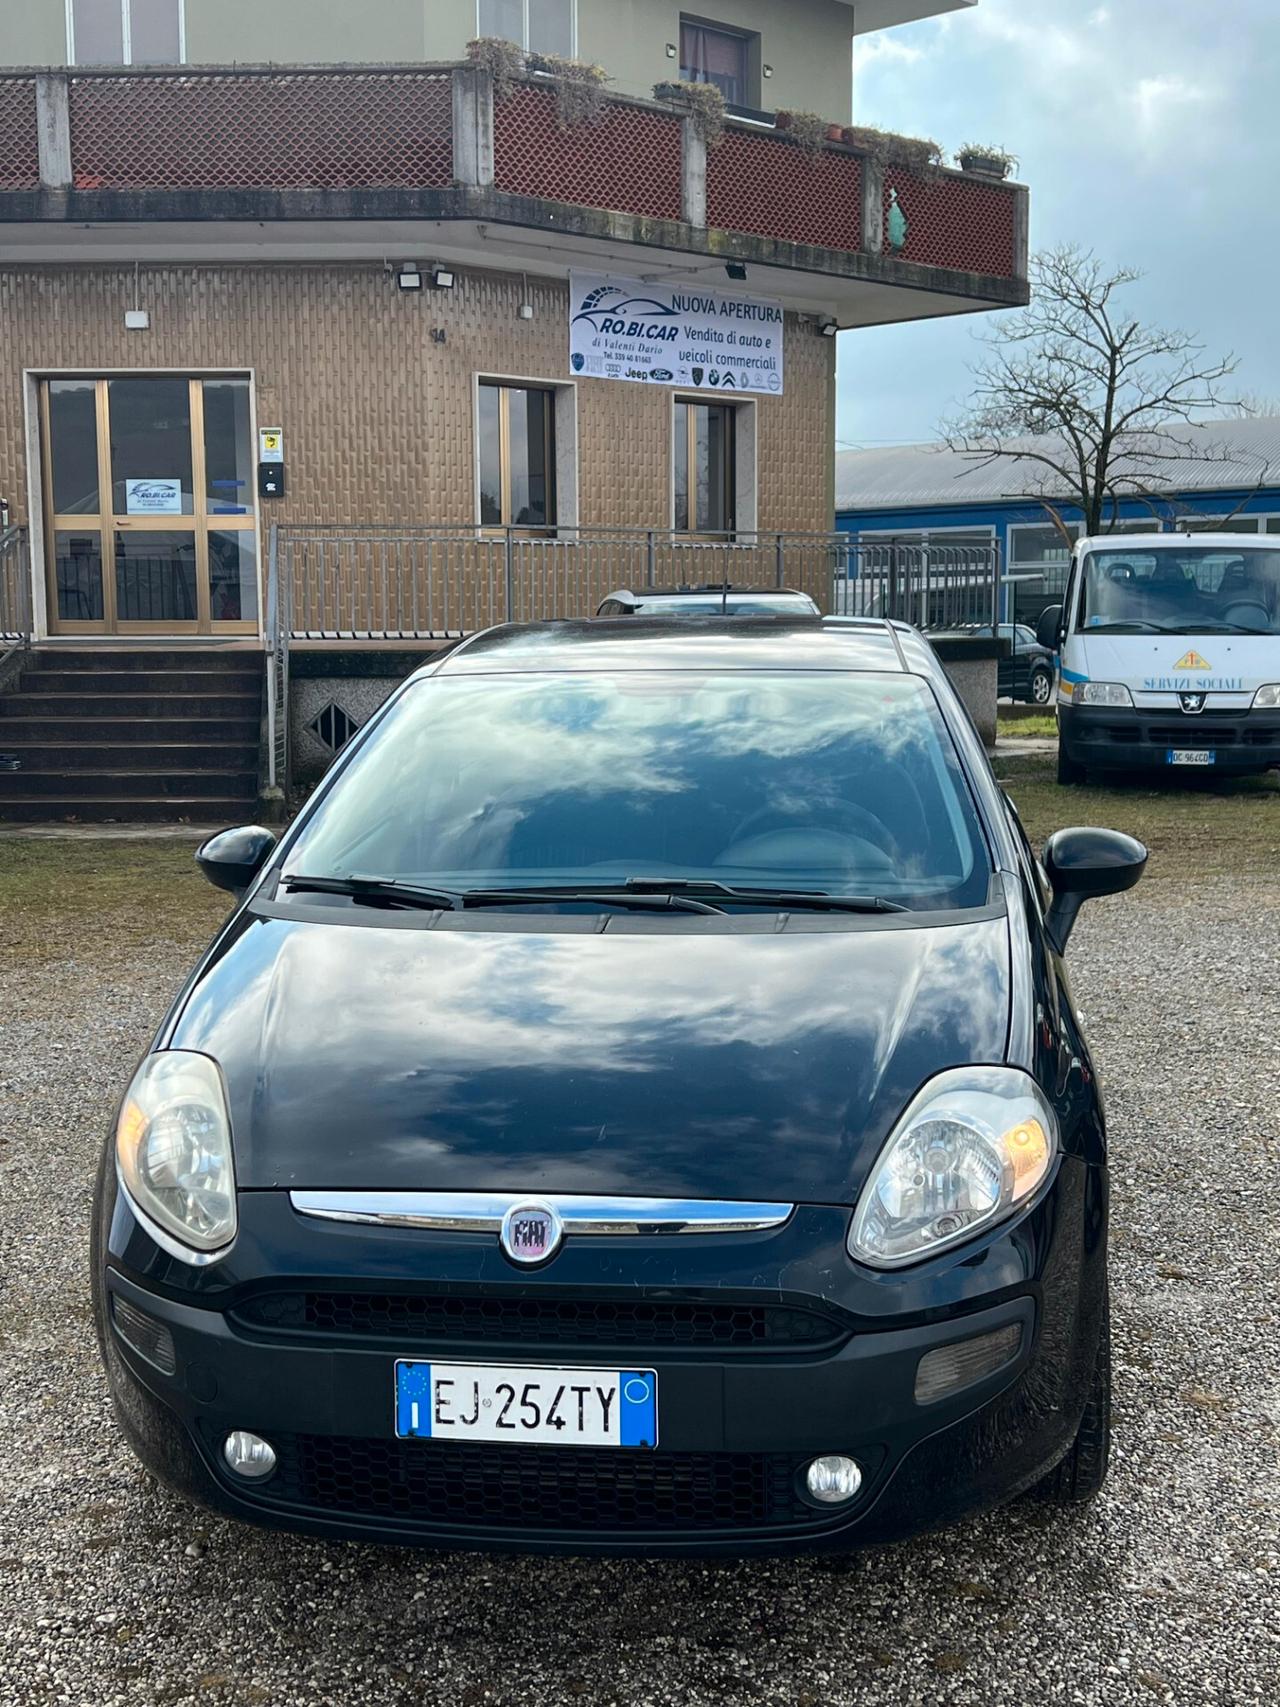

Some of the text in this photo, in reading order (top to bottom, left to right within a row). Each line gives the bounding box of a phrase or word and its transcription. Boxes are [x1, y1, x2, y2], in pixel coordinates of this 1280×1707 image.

[672, 294, 783, 323] NUOVA APERTURA
[600, 318, 679, 341] RO.BI.CAR
[684, 325, 772, 348] Vendita di auto e
[592, 338, 663, 354] di Valenti Dario
[679, 348, 776, 370] veicoli commerciali
[625, 367, 648, 381] Jeep
[1144, 678, 1242, 689] SERVIZI SOCIALI
[514, 1220, 546, 1247] FIAT
